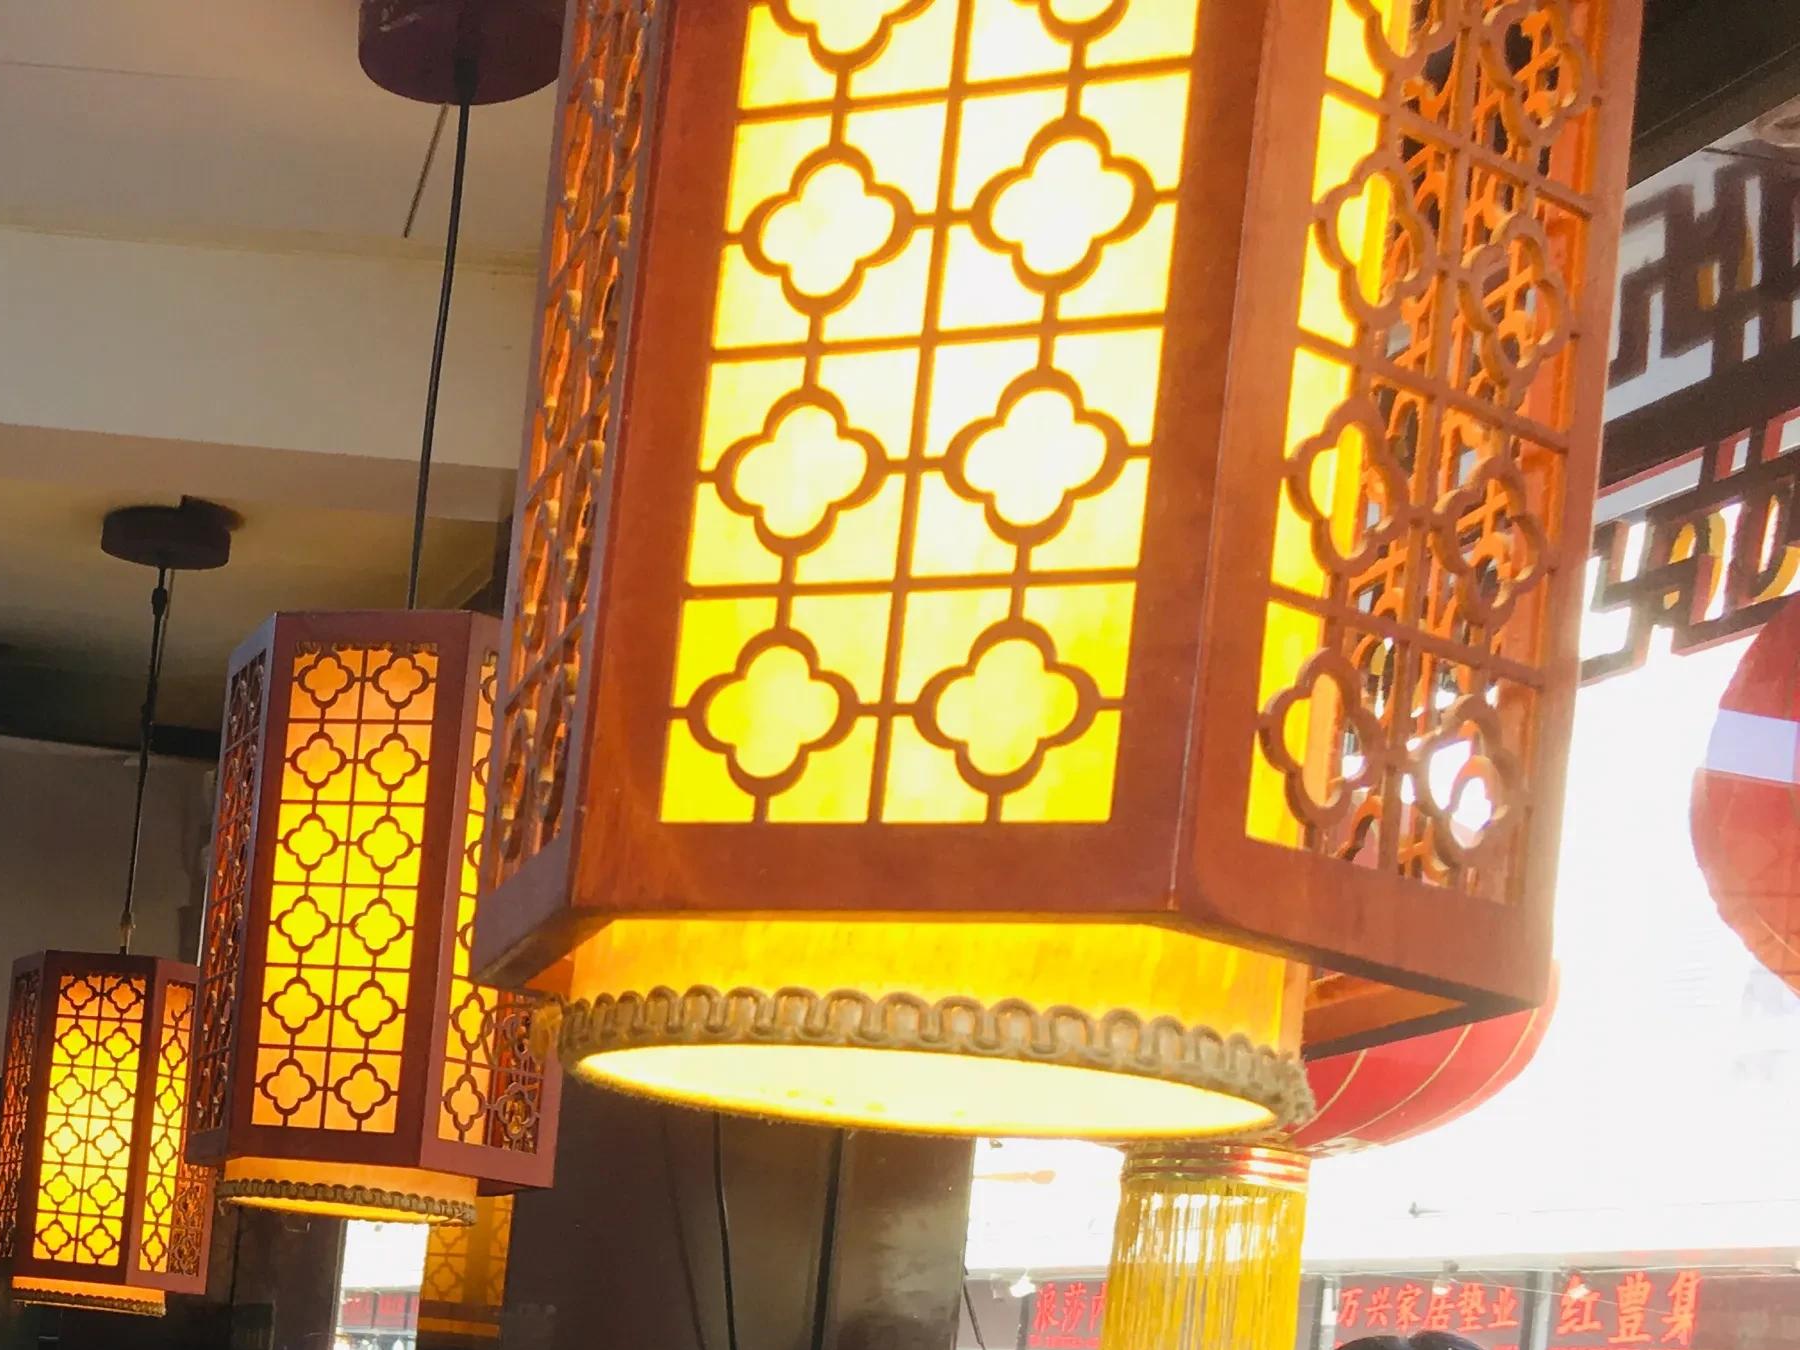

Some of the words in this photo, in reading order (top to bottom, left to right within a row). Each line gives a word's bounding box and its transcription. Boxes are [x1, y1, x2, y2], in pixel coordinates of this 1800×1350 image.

[1336, 1283, 1519, 1332] 万兴家居垫业
